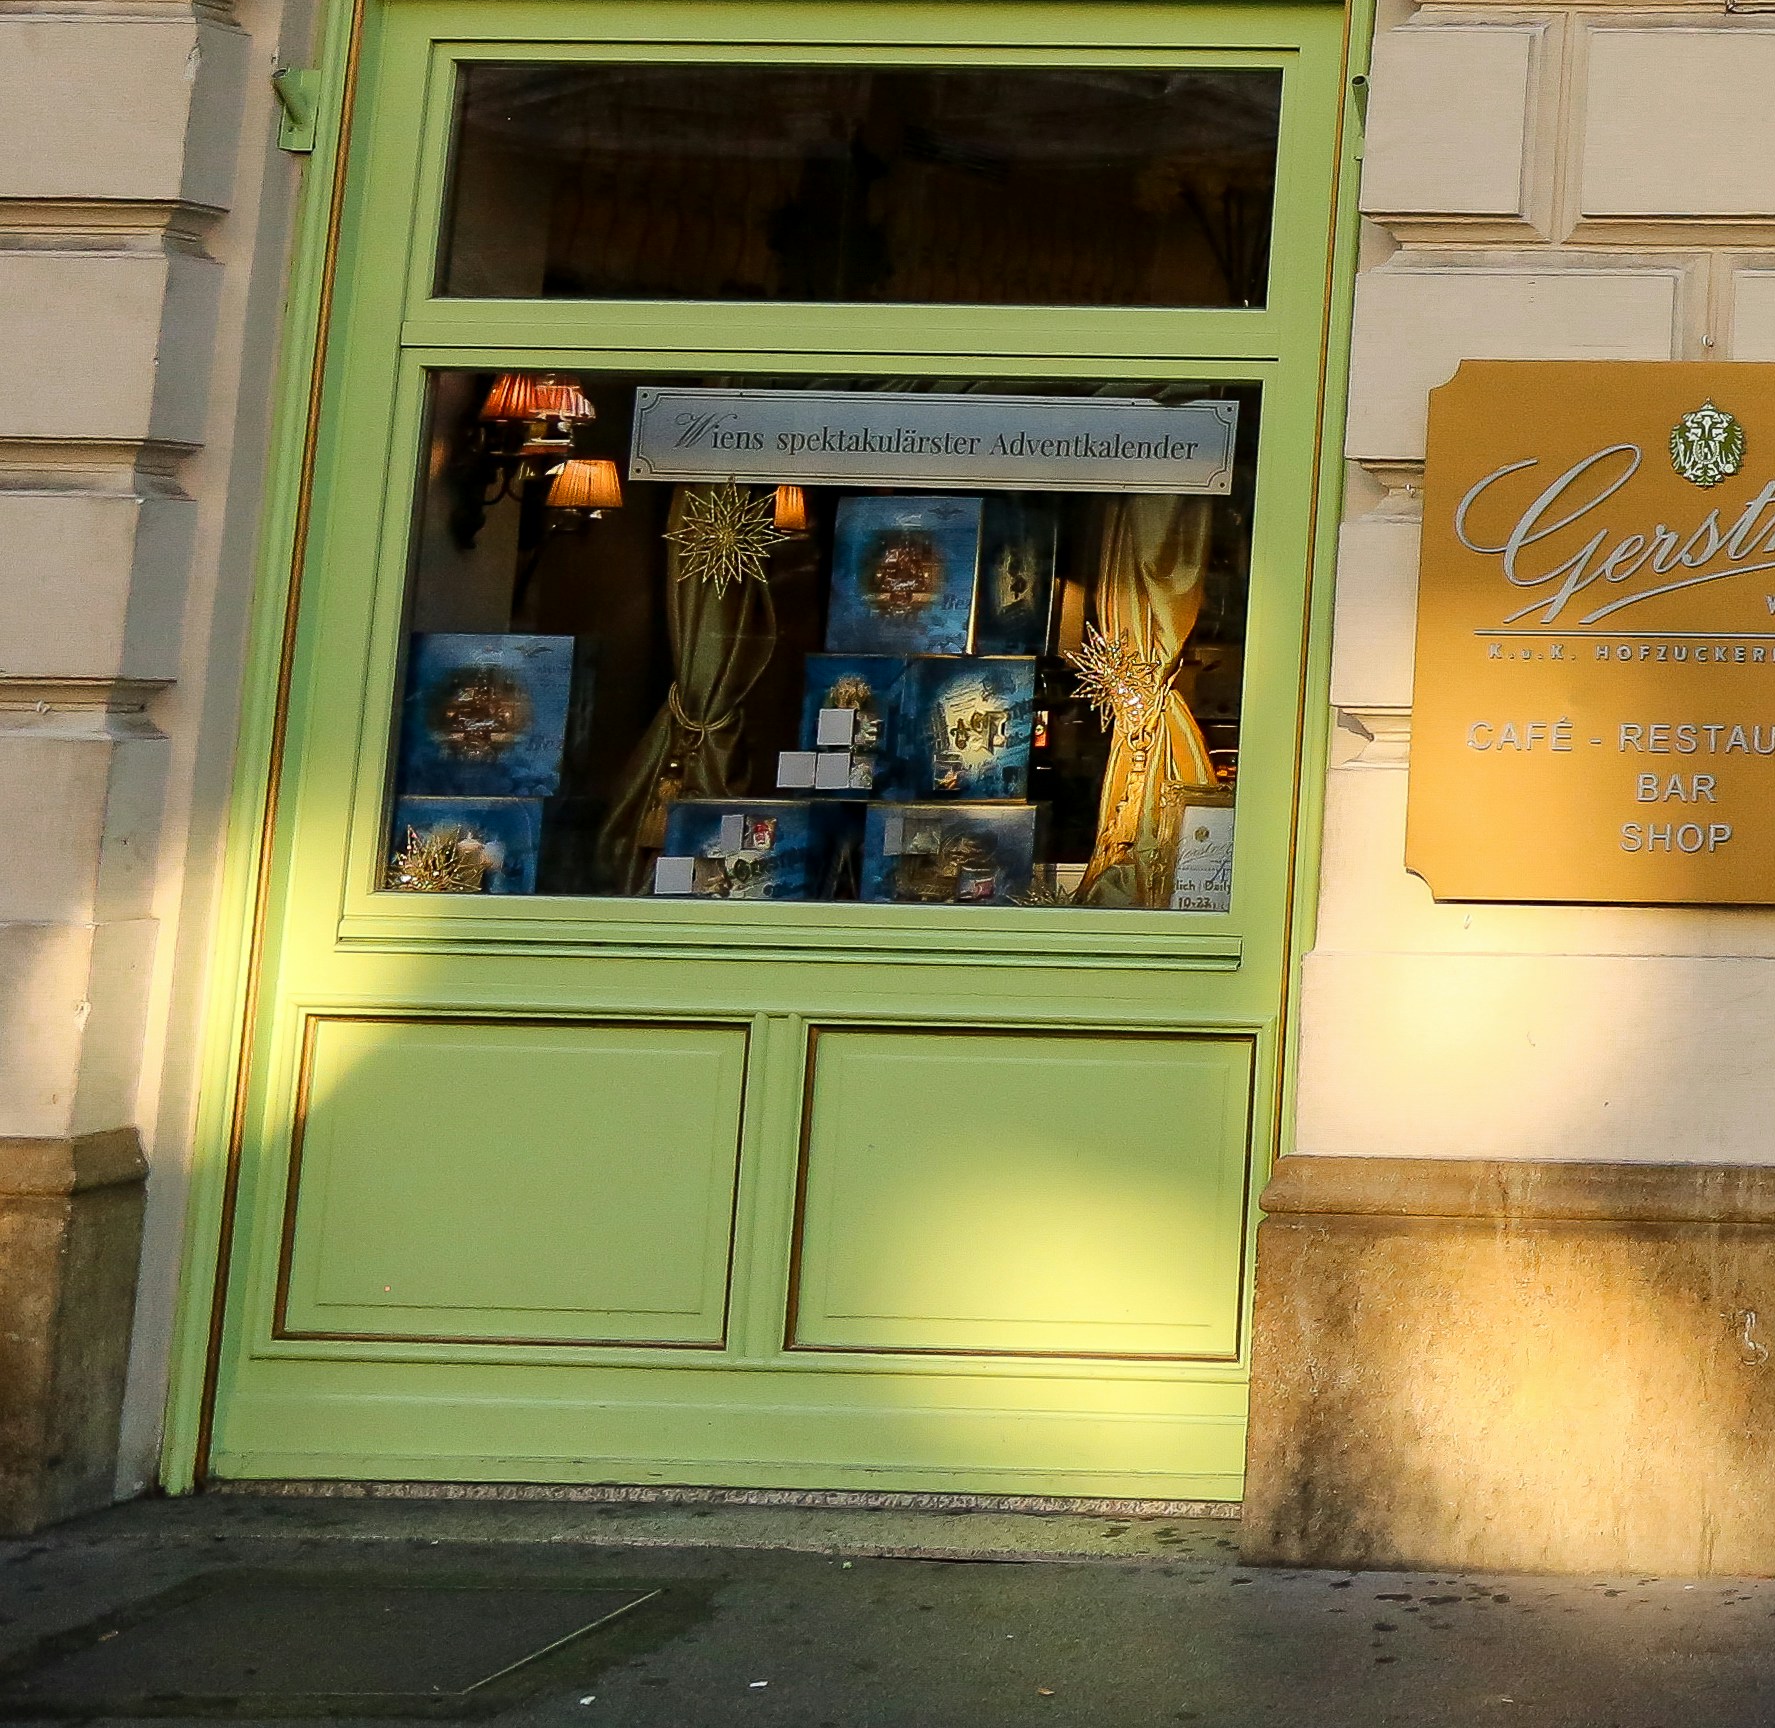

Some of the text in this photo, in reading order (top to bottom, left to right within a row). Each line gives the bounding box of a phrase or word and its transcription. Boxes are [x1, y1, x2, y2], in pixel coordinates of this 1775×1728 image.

[672, 412, 1199, 461] Wiens spektakulärster Adventkalender
[1467, 716, 1574, 752] CAFÉ
[1636, 773, 1718, 803] BAR
[1620, 822, 1733, 853] SHOP
